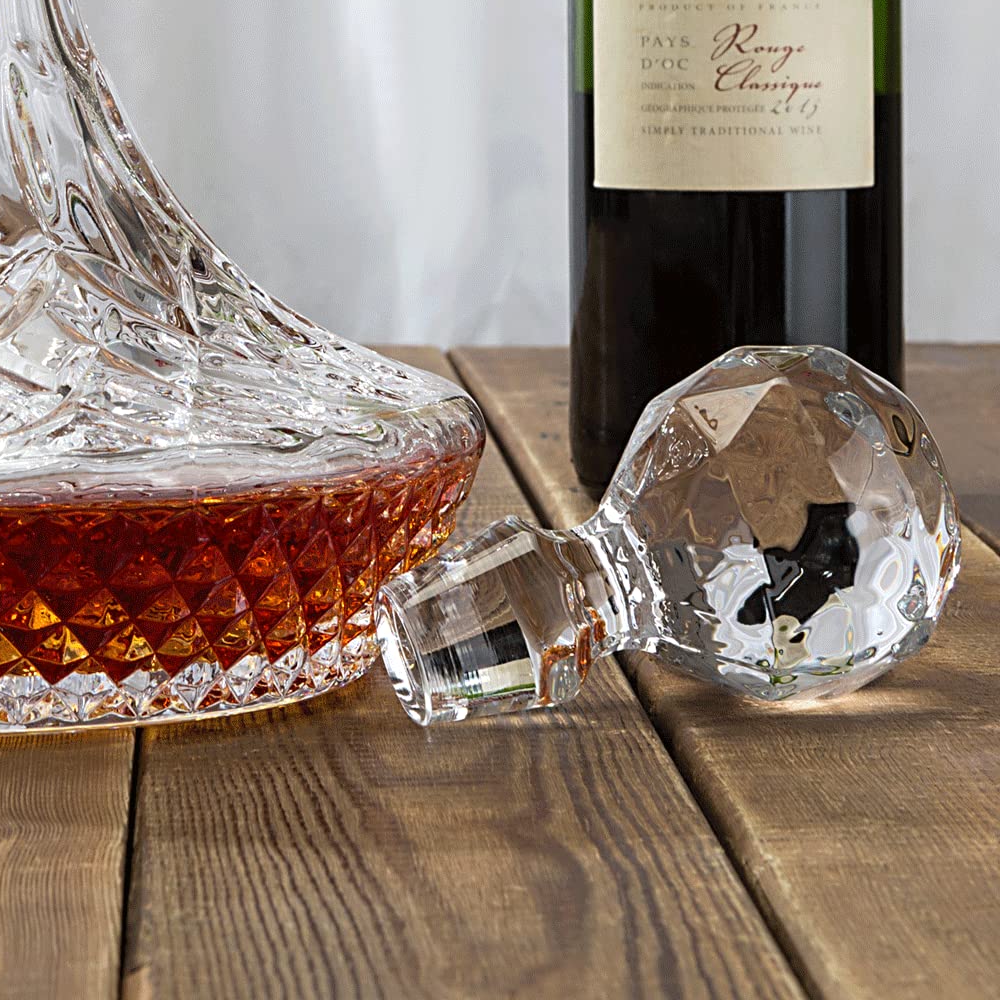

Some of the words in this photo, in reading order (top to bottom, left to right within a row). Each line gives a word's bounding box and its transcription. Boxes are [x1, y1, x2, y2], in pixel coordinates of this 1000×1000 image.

[638, 3, 714, 12] PRODUCT
[726, 3, 746, 12] OF
[757, 2, 822, 12] FRANCE
[641, 35, 691, 48] PAYS
[710, 22, 807, 74] Rouge
[641, 58, 689, 71] D'OC
[640, 81, 696, 91] INDICATION
[713, 58, 824, 103] Classique
[640, 125, 685, 136] SIMPLY
[691, 125, 784, 136] TRADITIONAL
[788, 125, 823, 136] WINE
